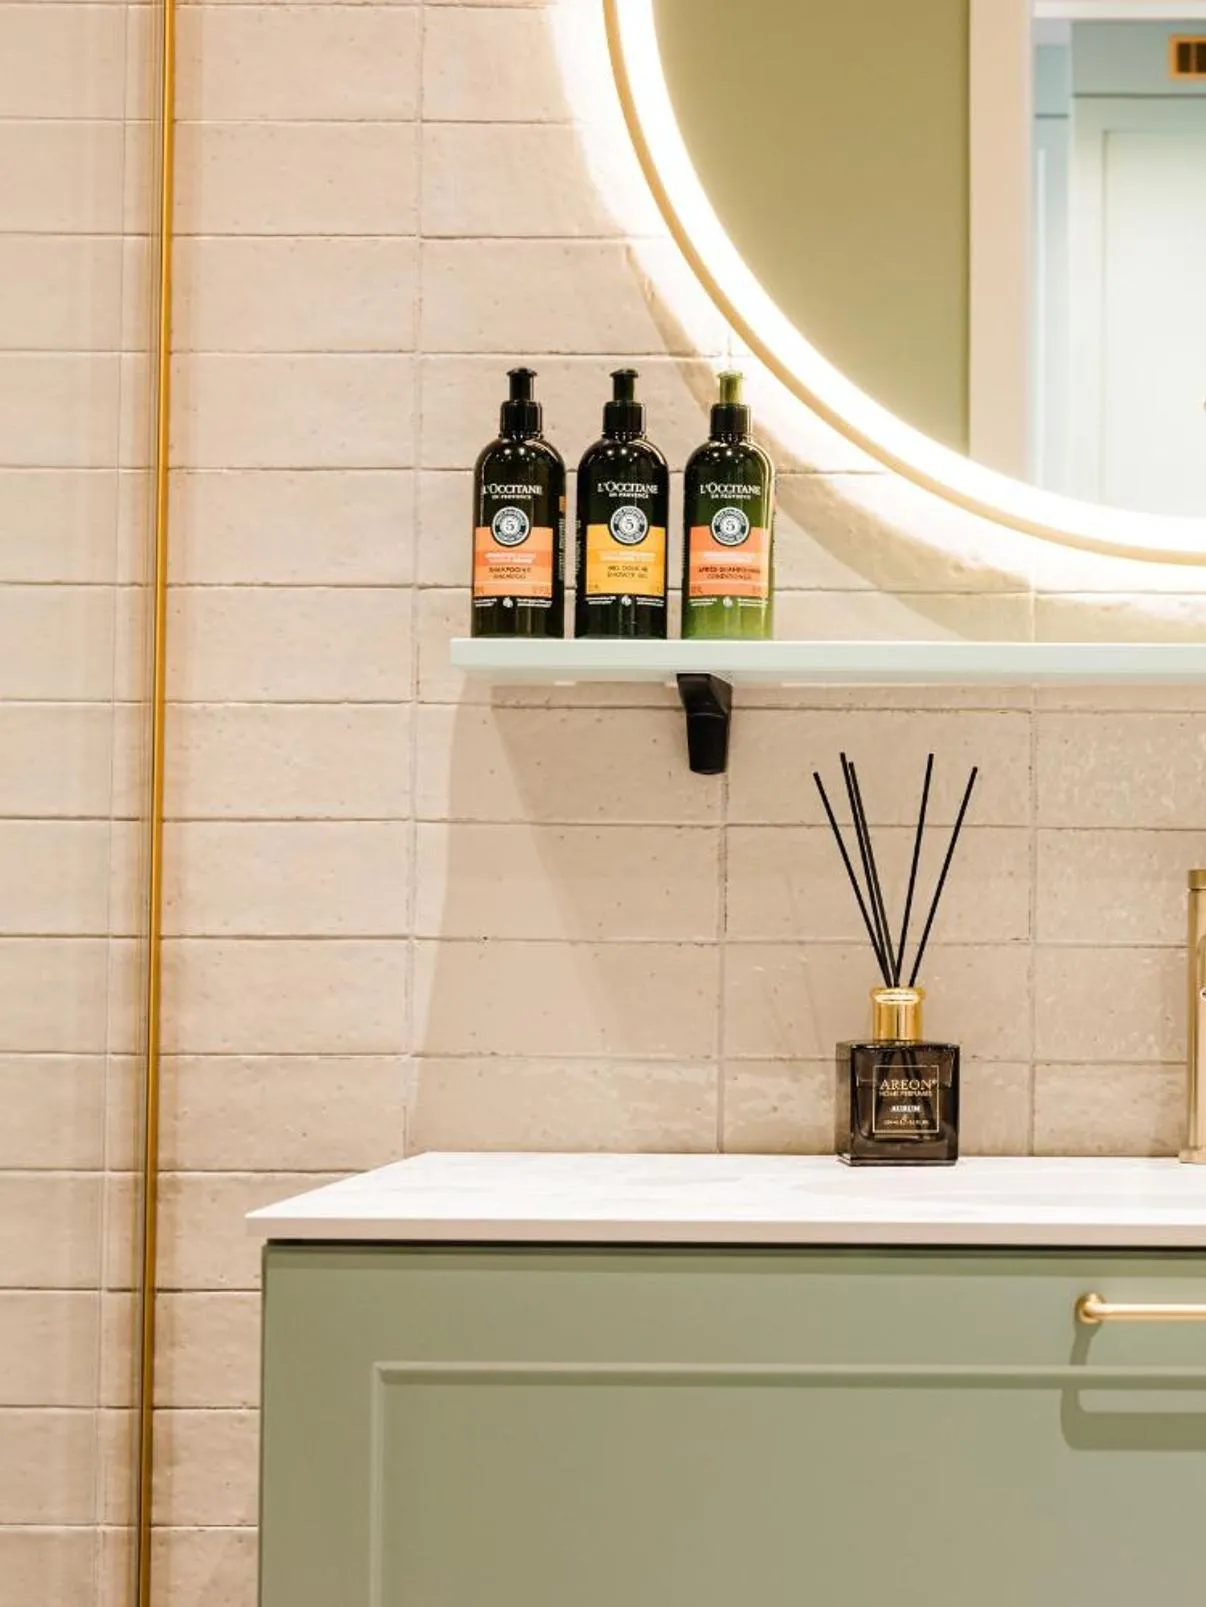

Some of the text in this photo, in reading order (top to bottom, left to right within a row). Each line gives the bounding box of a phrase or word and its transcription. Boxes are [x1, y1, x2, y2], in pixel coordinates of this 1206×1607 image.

[597, 481, 659, 494] L'OCCITANE
[700, 482, 761, 495] L'OCCITANE
[505, 520, 515, 531] 5
[726, 520, 735, 531] 5
